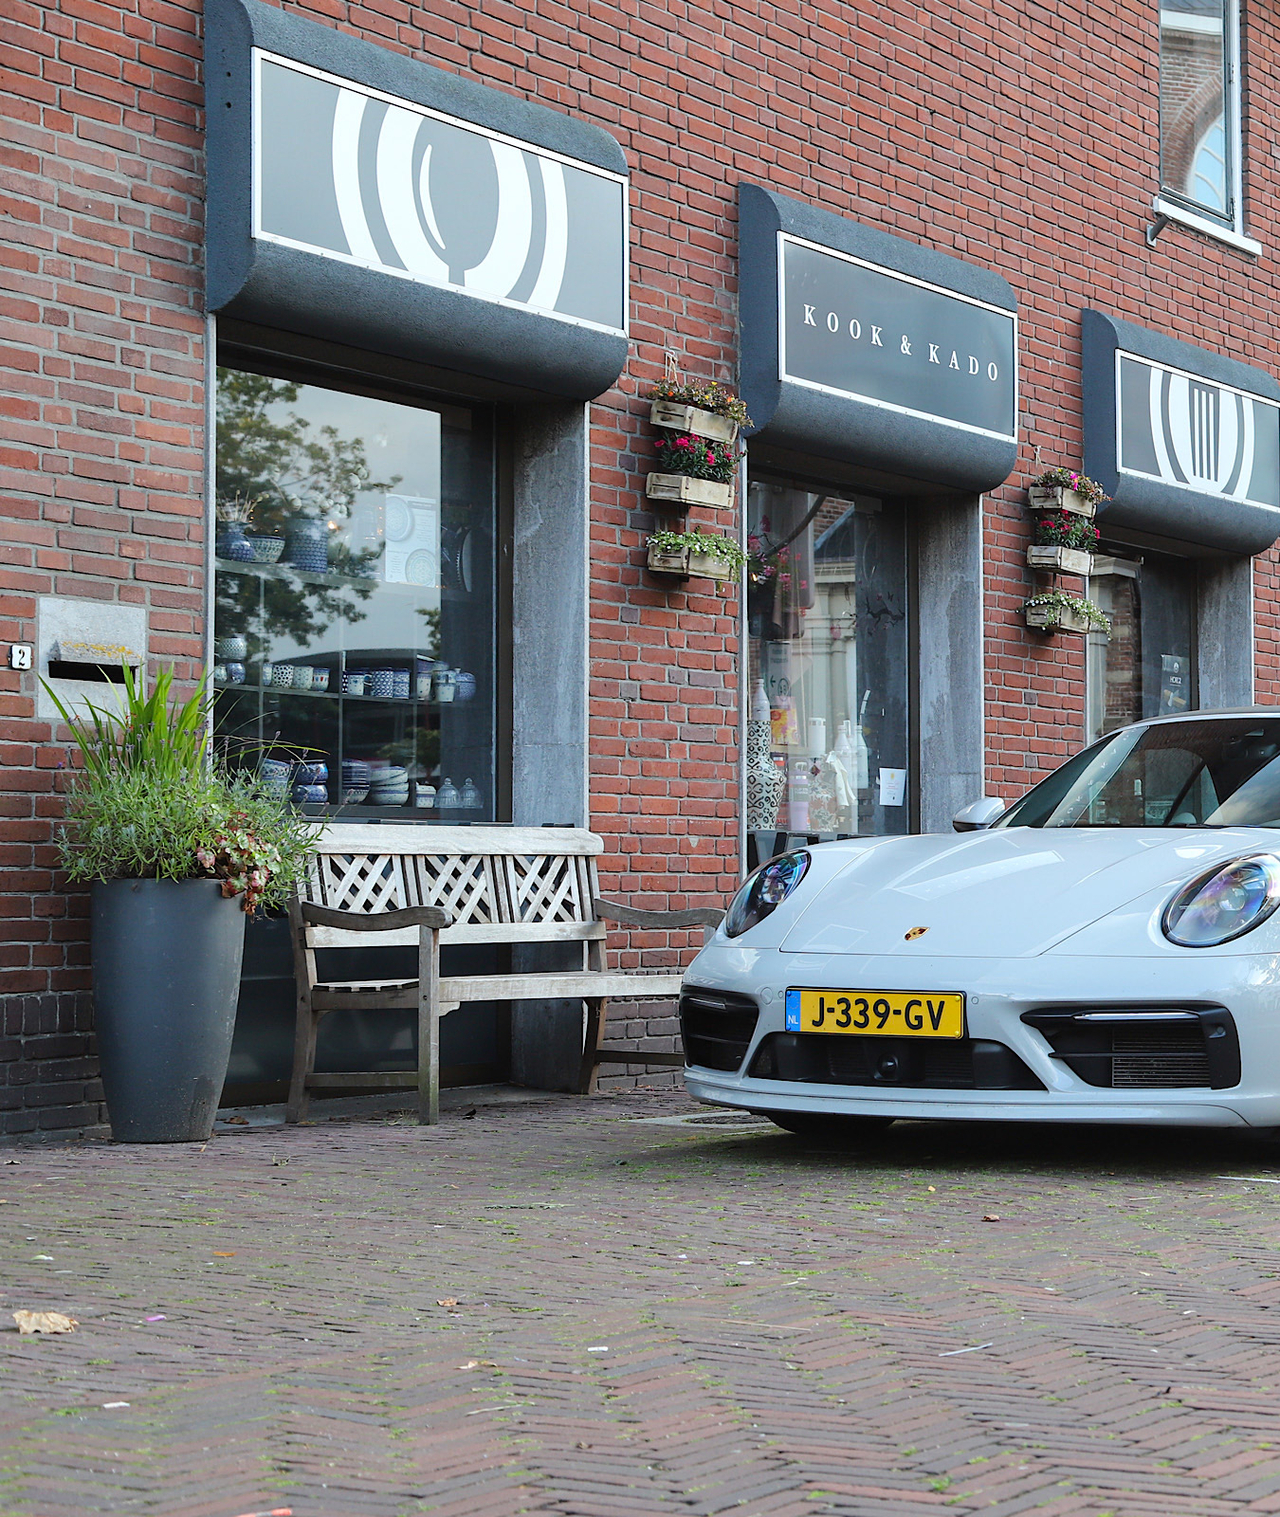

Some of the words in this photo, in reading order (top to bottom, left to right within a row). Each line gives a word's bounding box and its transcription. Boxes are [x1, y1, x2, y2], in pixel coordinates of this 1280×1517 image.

[803, 304, 883, 347] KOOK
[900, 335, 912, 356] &
[928, 343, 998, 381] KADO
[18, 649, 26, 667] 2
[787, 1014, 799, 1025] NL
[811, 996, 946, 1031] J-339-GV
